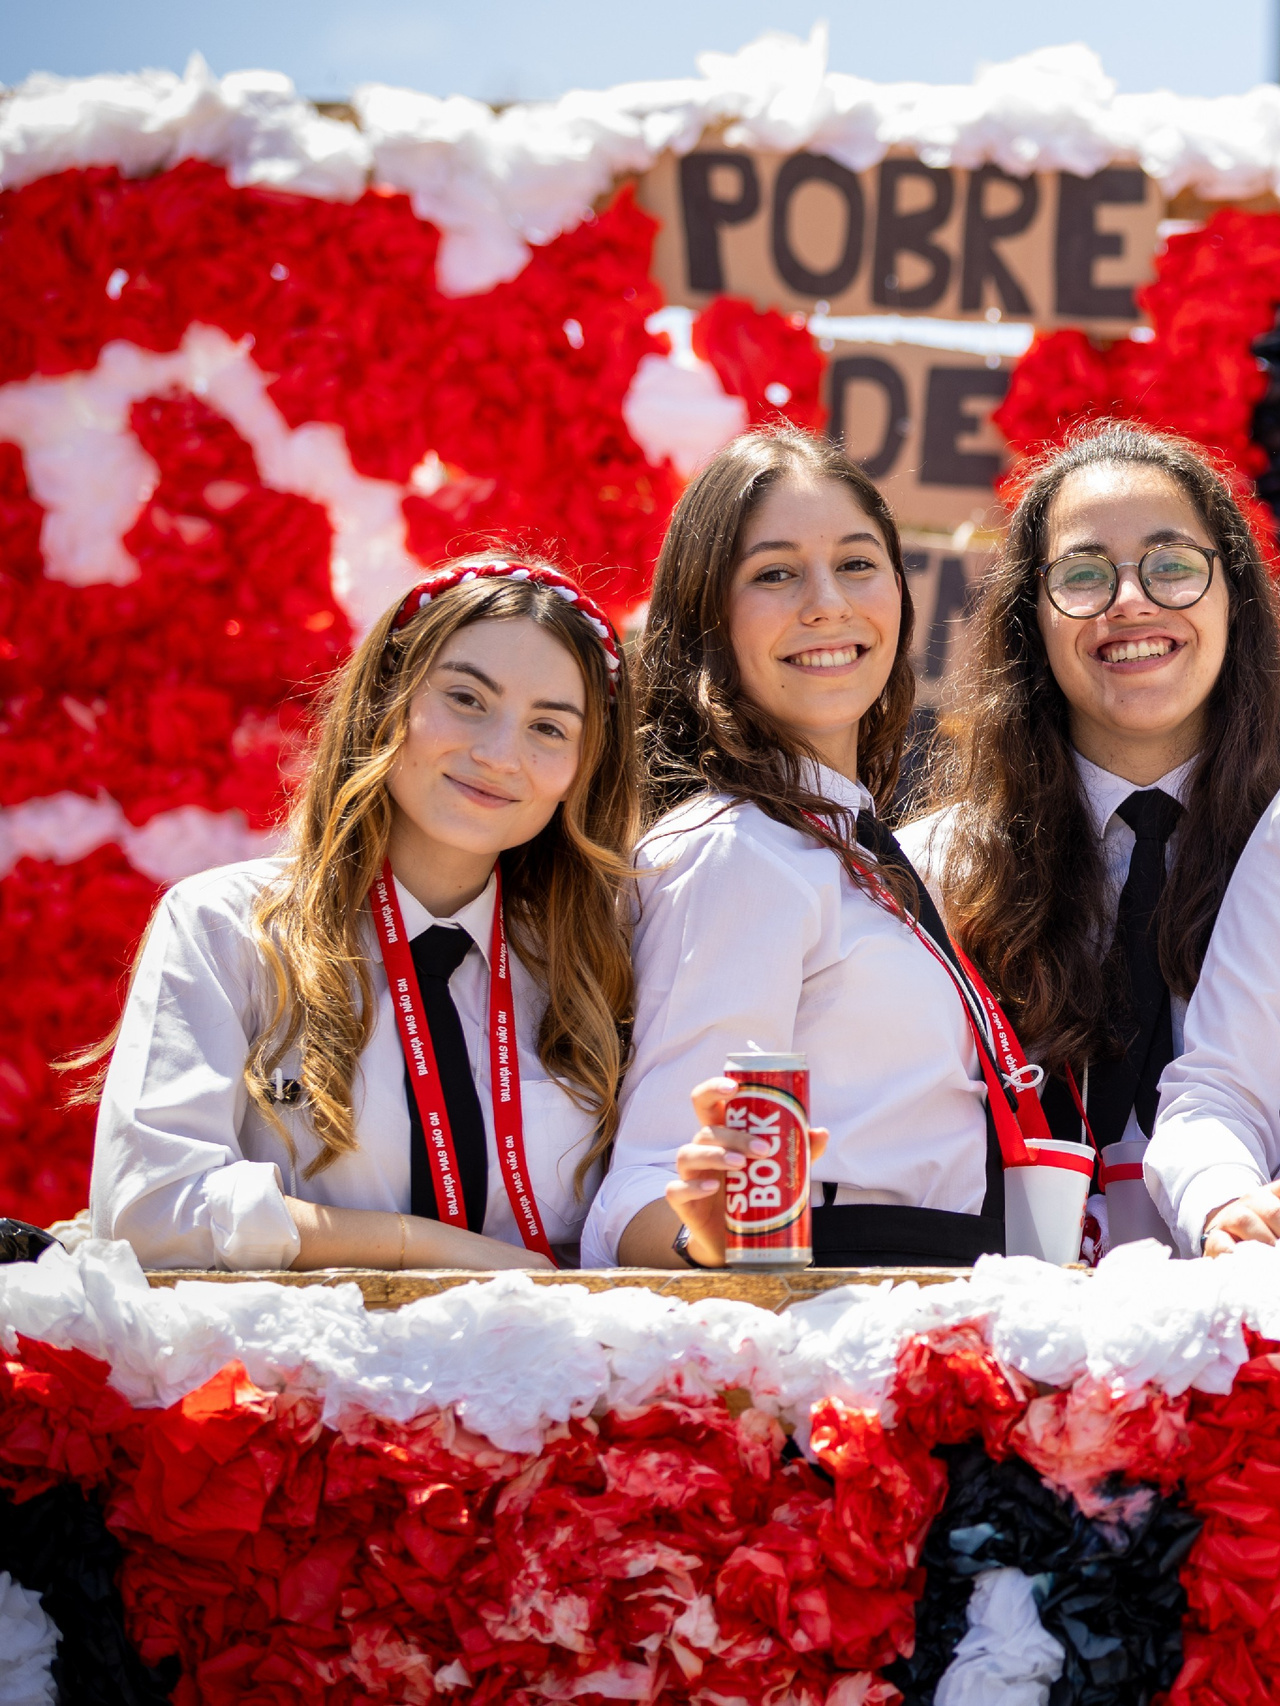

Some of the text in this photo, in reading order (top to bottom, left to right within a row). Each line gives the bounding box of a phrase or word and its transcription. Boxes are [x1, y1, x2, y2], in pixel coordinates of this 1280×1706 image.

[679, 152, 1145, 318] POBRE
[828, 356, 1012, 487] DE
[376, 882, 390, 903] MAS
[382, 904, 398, 944] BALANÇA
[397, 978, 428, 1076] BALANÇA MAS NÃO CAI
[986, 996, 995, 1010] CAI
[992, 1012, 1004, 1030] NÃO
[998, 1032, 1010, 1052] MAS
[496, 1010, 512, 1102] BALANÇA MAS NÃO CAI
[428, 1112, 459, 1216] BALANÇA MAS NÃO CAI
[505, 1135, 539, 1236] BALANÇA MAS NÃO CAI
[725, 1106, 748, 1214] SUR
